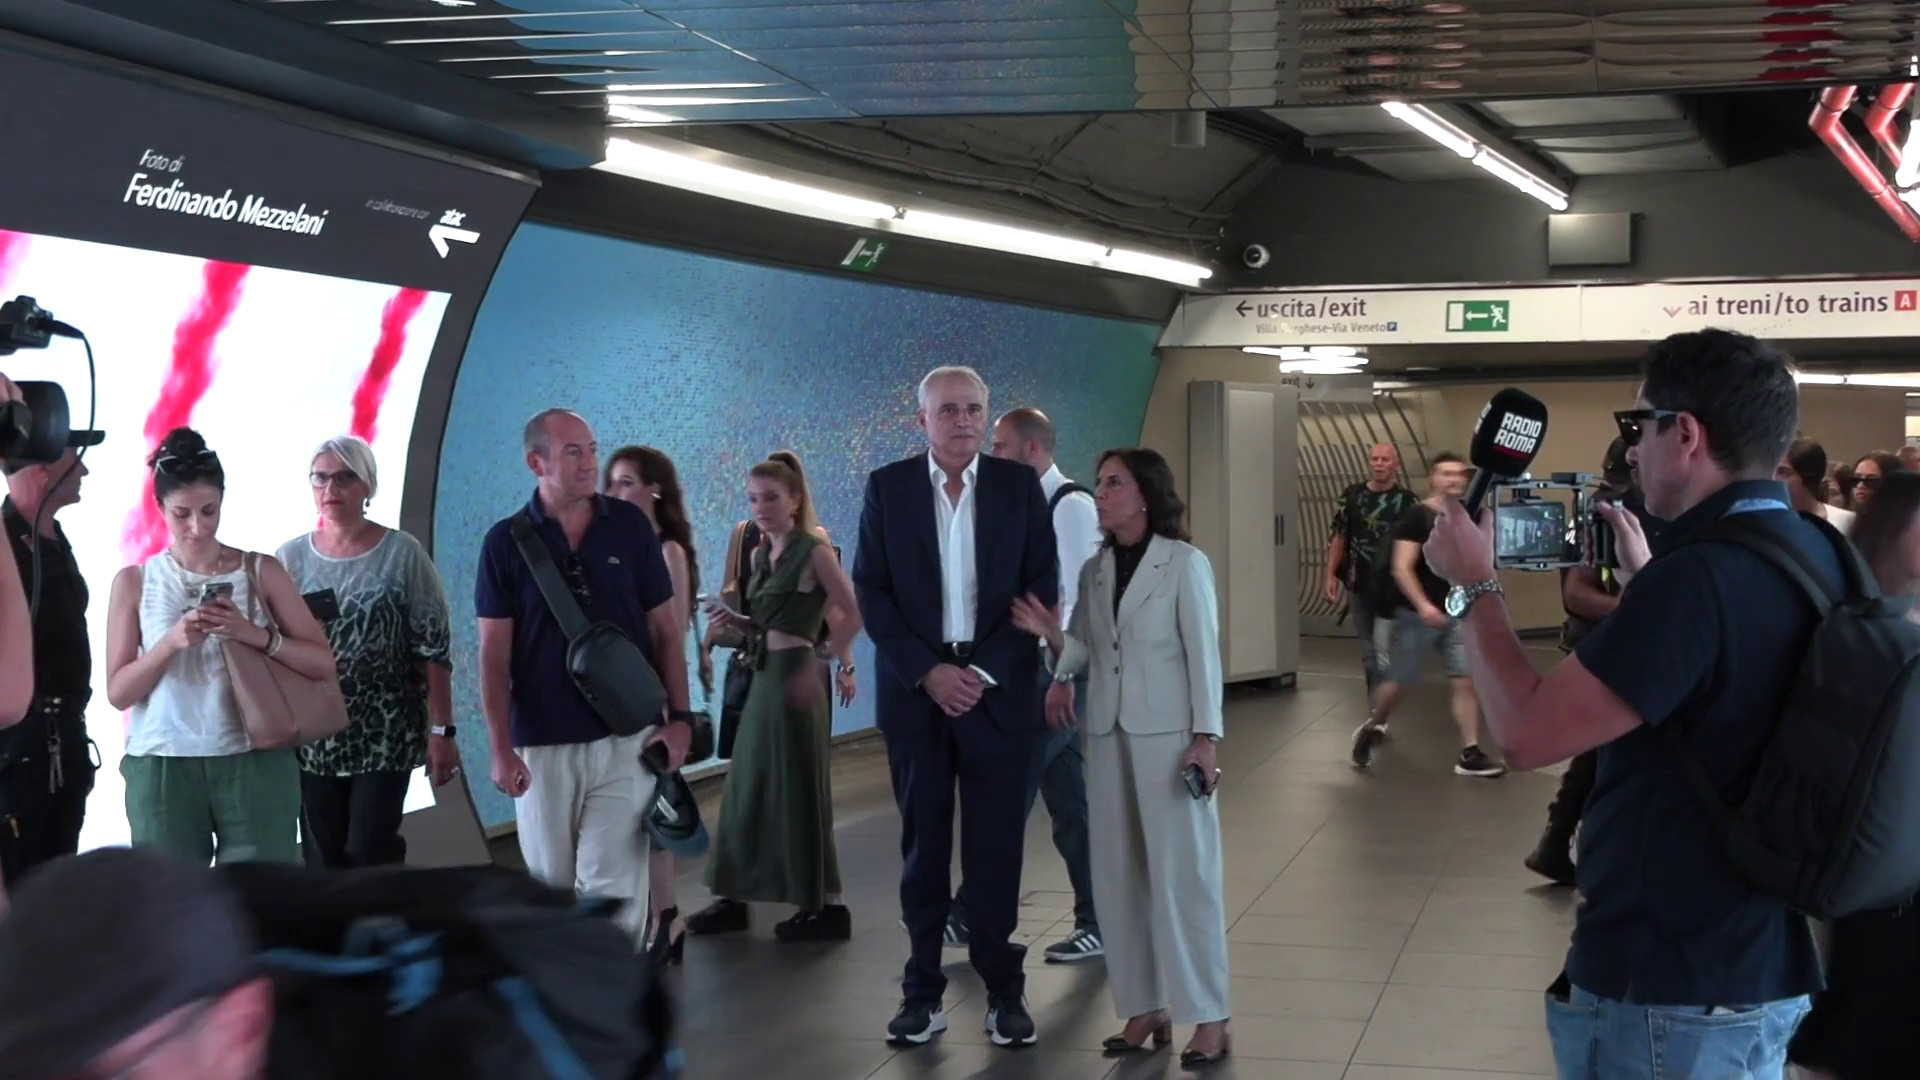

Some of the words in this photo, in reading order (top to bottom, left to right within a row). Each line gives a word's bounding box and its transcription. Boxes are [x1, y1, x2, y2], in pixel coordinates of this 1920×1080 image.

[139, 149, 169, 170] Foto
[169, 155, 186, 172] di
[123, 172, 238, 221] Ferdinando
[237, 194, 330, 236] Mezzelani
[1257, 296, 1367, 318] uscita/exit
[1688, 294, 1708, 316] ai
[1716, 292, 1810, 316] treni/to
[1819, 291, 1889, 313] trains
[1255, 322, 1278, 334] Villa
[1351, 322, 1387, 333] Veneto
[1501, 411, 1543, 438] RADIO
[1493, 428, 1538, 455] ROMA
